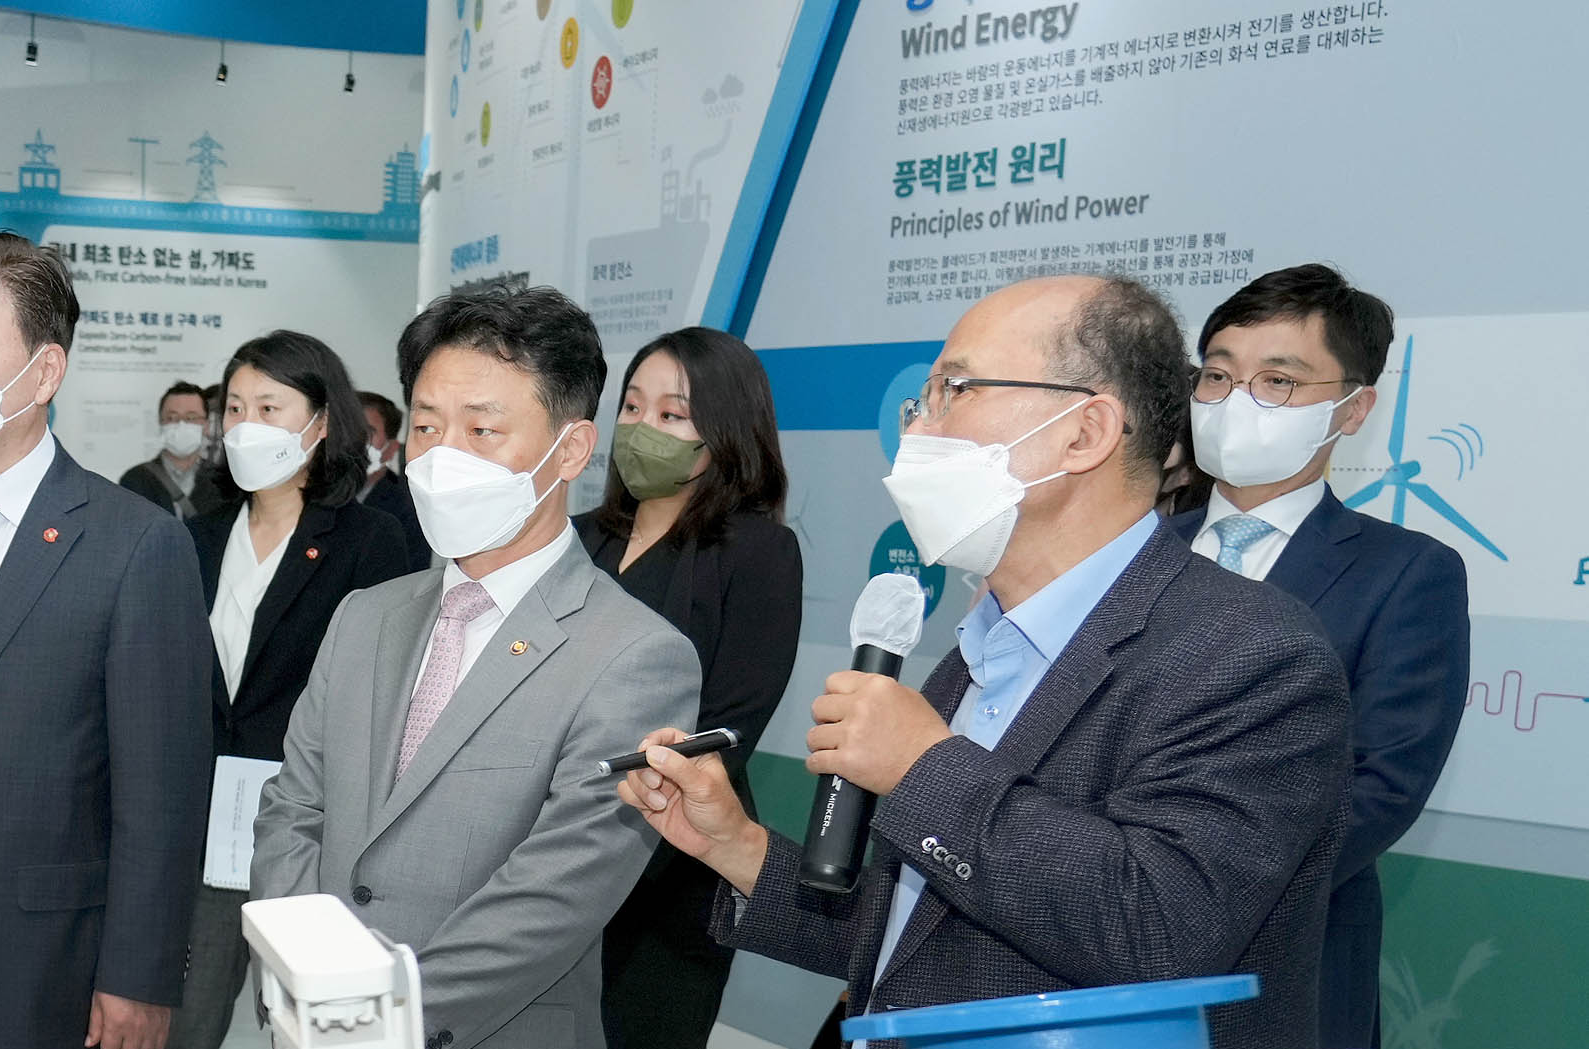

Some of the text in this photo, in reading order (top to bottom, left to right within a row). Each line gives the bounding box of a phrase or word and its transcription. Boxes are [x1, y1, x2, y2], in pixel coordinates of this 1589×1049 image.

[901, 2, 1079, 59] Wind Energy
[899, 0, 1389, 96] 풍력에너지는 바람의 운동에너지를 기계적 에너지로 변환시켜 전기를 생산합니다.
[958, 87, 979, 105] 오염
[983, 82, 1005, 102] 물질
[1025, 66, 1086, 95] 온실가스를
[1090, 60, 1144, 84] 배출하지
[1148, 55, 1176, 76] 않아
[1179, 48, 1223, 71] 기존의
[1227, 41, 1258, 63] 화석
[1263, 35, 1311, 59] 연료를
[1317, 25, 1384, 50] 대체하는
[998, 97, 1044, 119] 각광받고
[1049, 89, 1102, 112] 있습니다.
[892, 137, 1067, 198] 풍력발전 원리
[890, 193, 1150, 238] Principles of Wind Power
[1154, 233, 1198, 251] 발전기를
[1203, 231, 1226, 248] 통해
[82, 243, 113, 264] 최초
[118, 245, 147, 266] 탄소
[153, 247, 183, 269] 없는
[188, 249, 208, 271] 섬,
[211, 250, 256, 271] 가파도
[1178, 251, 1213, 268] 공장과
[1217, 248, 1254, 265] 가정에
[95, 269, 119, 282] First
[121, 270, 186, 286] Carbon-free
[189, 273, 221, 287] Island
[224, 275, 234, 287] in
[237, 276, 268, 289] Korea
[1189, 268, 1252, 287] 공급됩니다.
